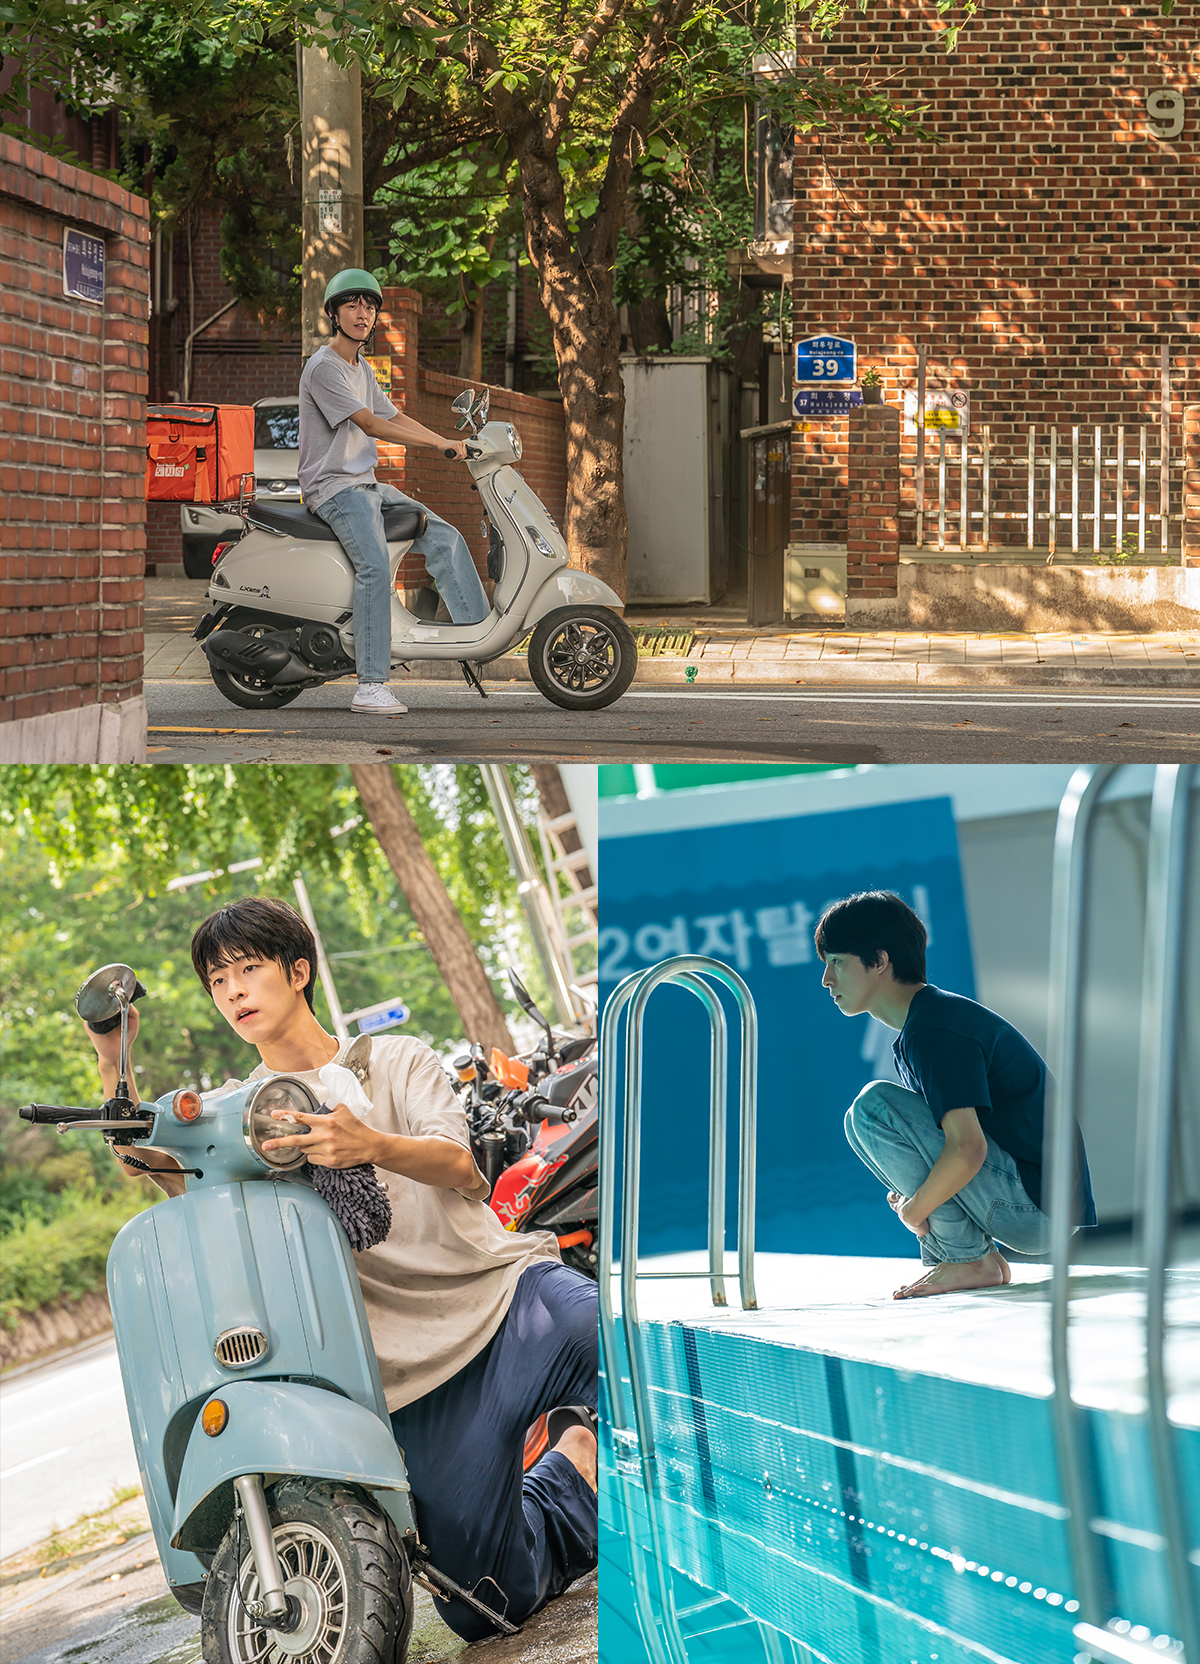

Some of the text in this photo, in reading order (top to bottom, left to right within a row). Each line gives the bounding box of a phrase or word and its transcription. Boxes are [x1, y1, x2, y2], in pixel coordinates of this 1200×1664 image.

[1146, 90, 1185, 138] 9
[81, 239, 103, 264] 희우정로
[812, 341, 841, 349] 희우정로
[812, 359, 839, 376] 39
